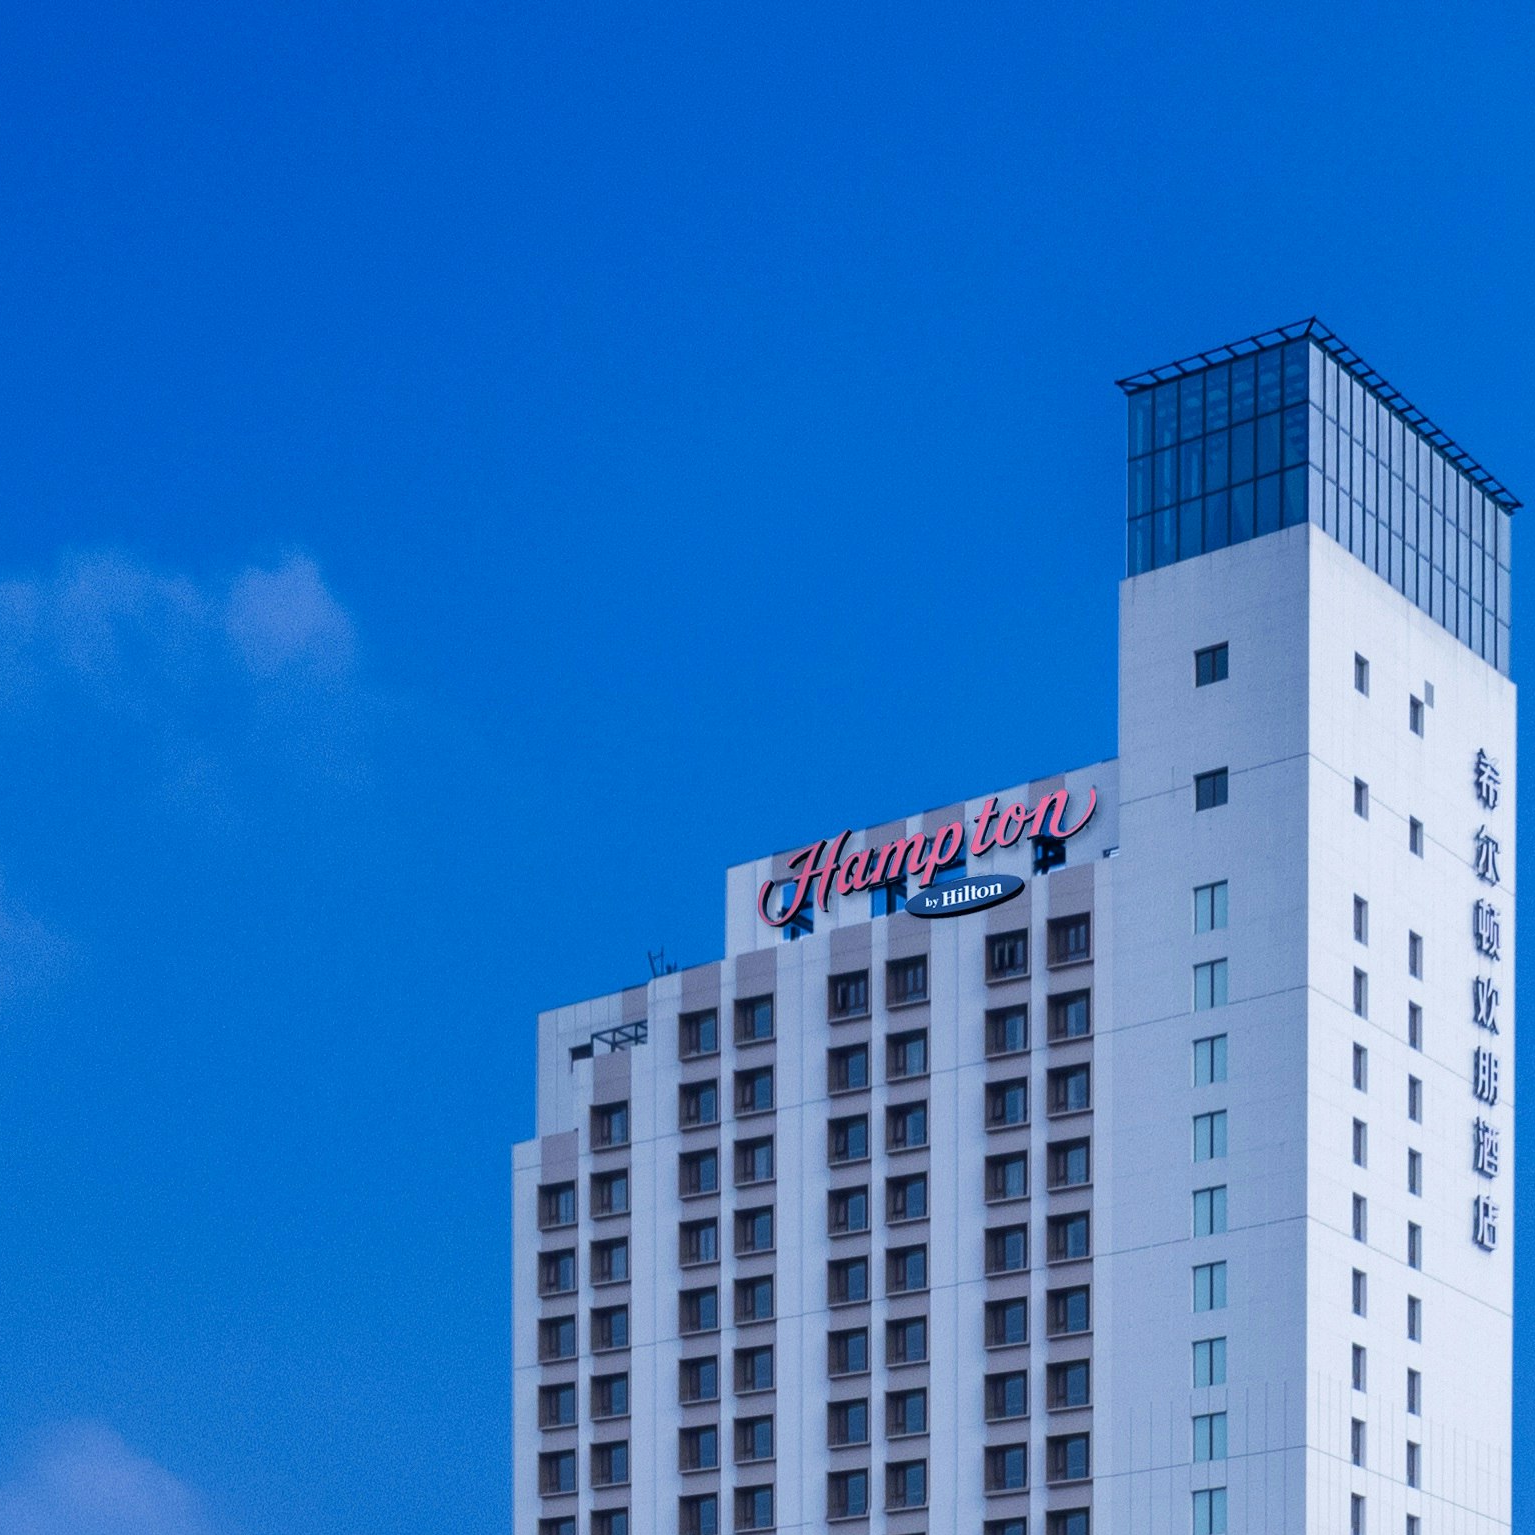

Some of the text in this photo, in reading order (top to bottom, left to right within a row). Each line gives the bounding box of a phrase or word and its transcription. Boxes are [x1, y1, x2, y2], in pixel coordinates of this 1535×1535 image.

[758, 786, 1098, 927] Hampton
[925, 881, 1003, 909] by Hilton
[1472, 748, 1501, 1252] 希尔顿欢朋酒店
